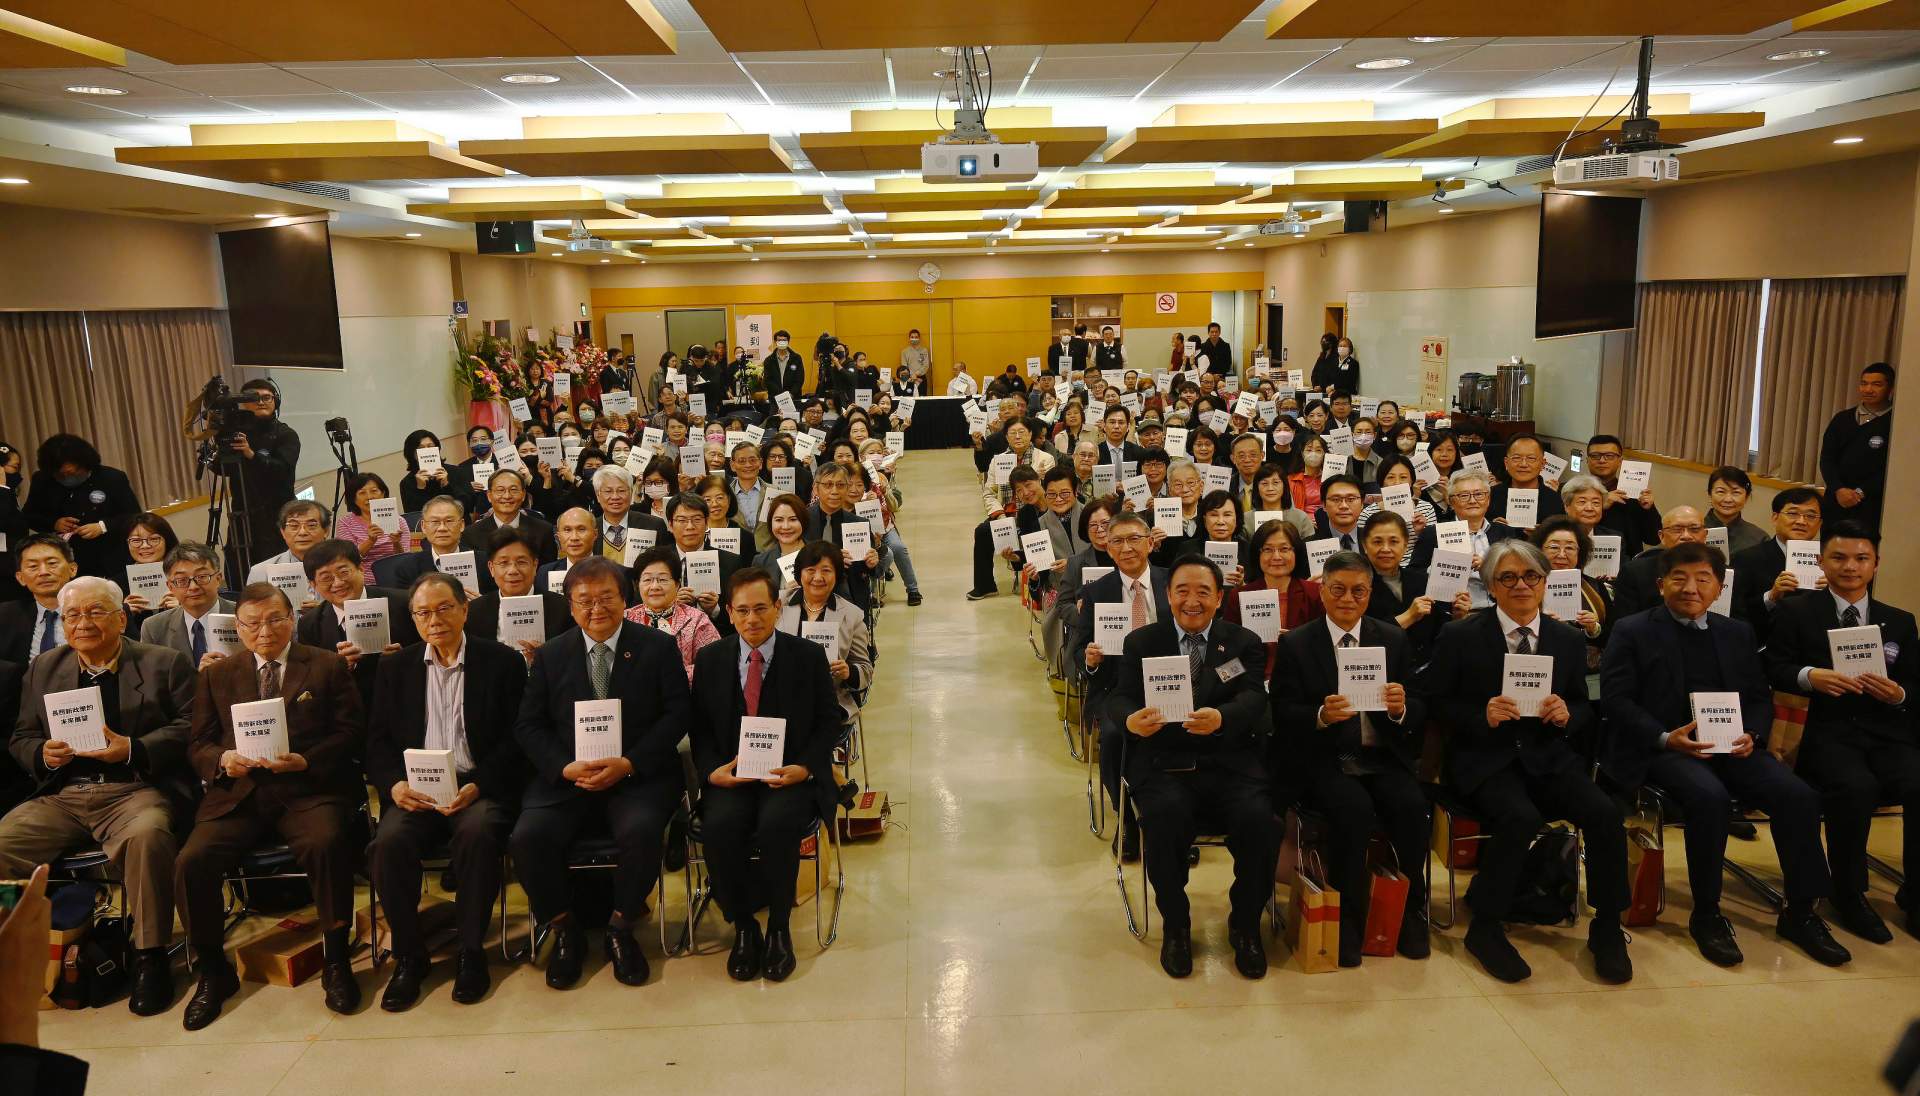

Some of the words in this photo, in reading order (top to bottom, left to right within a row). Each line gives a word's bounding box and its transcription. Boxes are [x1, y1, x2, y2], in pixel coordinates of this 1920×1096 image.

[750, 323, 759, 346] 報到
[1837, 643, 1877, 651] 長照新政策的
[52, 705, 93, 716] 長照新政策的
[61, 715, 88, 725] 未來展望
[238, 718, 276, 727] 長照新政策的
[579, 715, 614, 723] 長照新政策的
[744, 732, 779, 741] 長照新政策的
